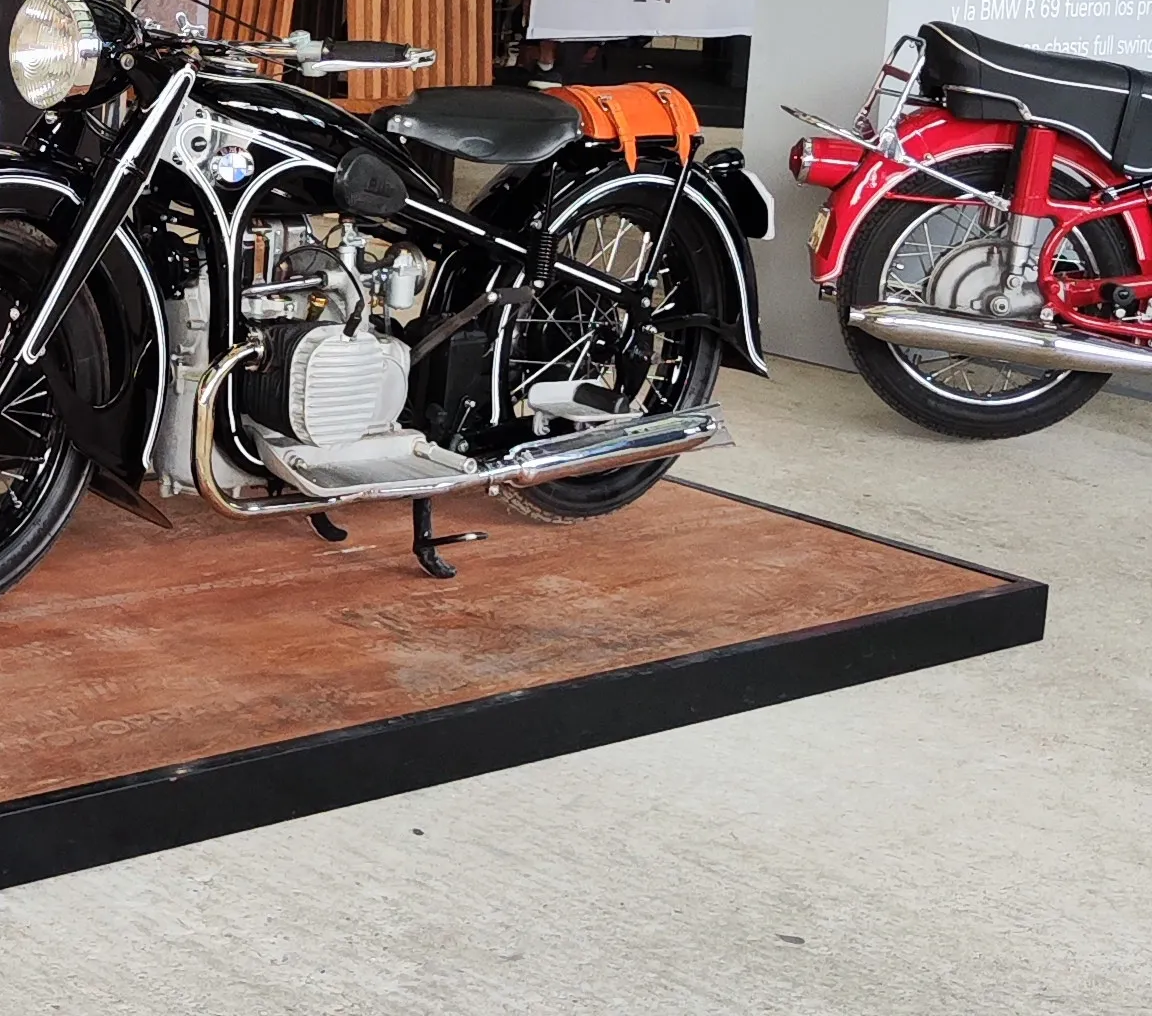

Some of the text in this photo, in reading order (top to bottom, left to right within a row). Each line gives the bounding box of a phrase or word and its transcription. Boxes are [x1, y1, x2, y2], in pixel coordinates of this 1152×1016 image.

[950, 4, 960, 24] y
[963, 0, 976, 20] la
[1093, 34, 1115, 56] full
